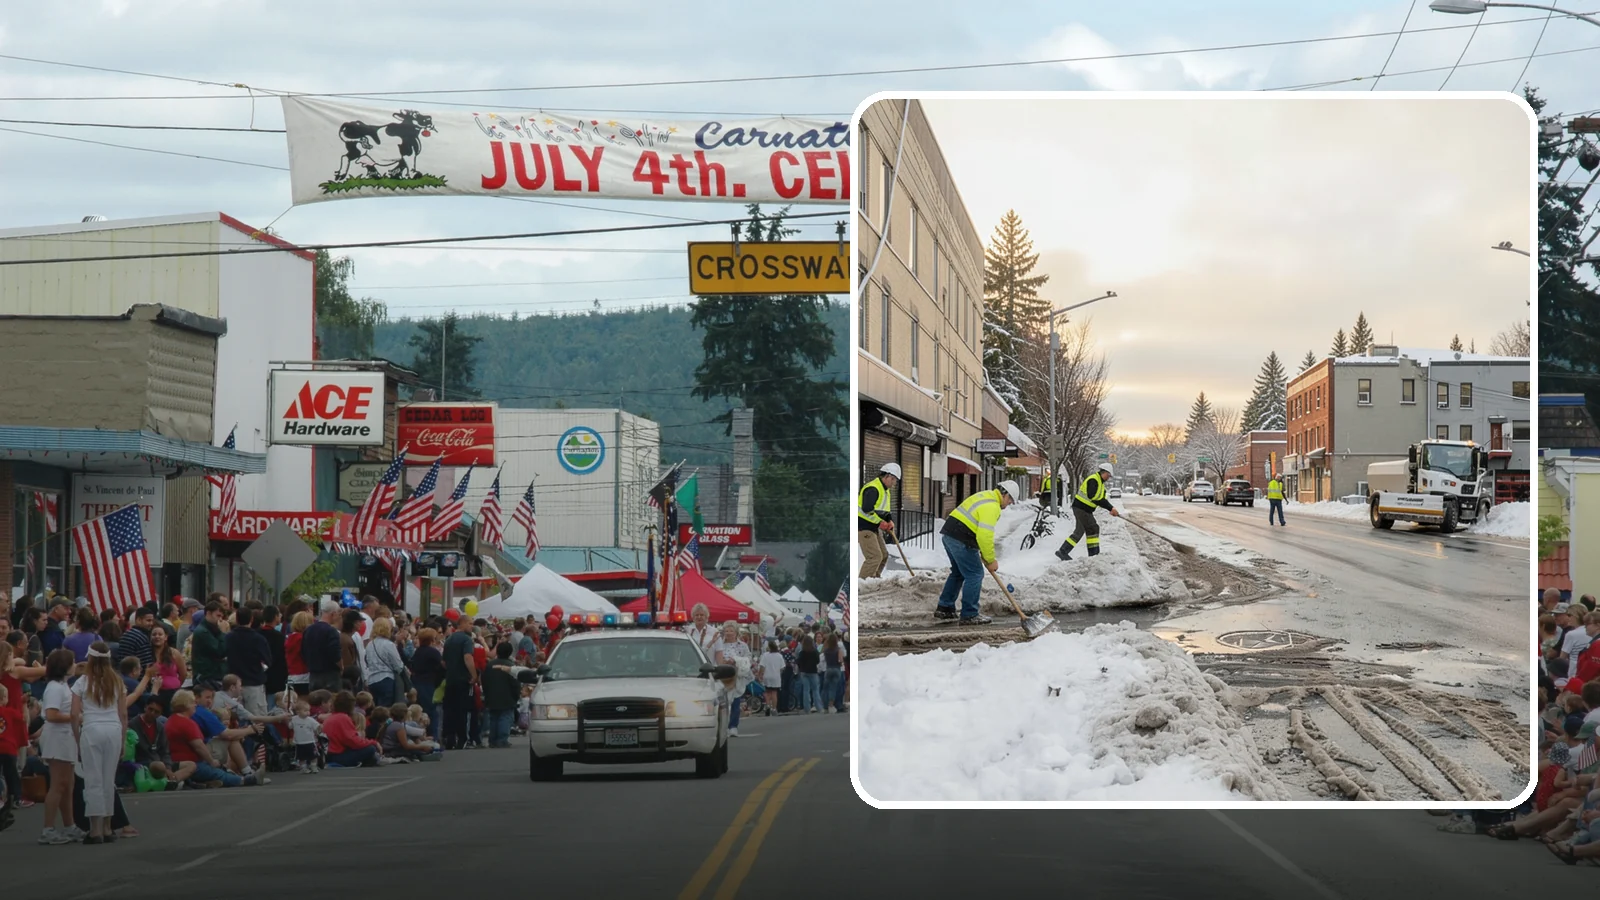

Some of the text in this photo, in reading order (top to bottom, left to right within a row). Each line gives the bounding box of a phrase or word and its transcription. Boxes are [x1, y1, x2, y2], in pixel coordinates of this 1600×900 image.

[481, 140, 605, 192] JULY
[632, 150, 746, 198] 4th.
[697, 254, 850, 280] CROSSWA
[282, 380, 373, 419] ACE
[405, 409, 485, 423] CEDAR LOG
[283, 421, 371, 436] Hardware
[416, 427, 477, 447] Coca-Cola
[83, 484, 155, 495] St. Vincent de Paul
[688, 526, 742, 535] CRNATION
[699, 535, 731, 543] GLASS
